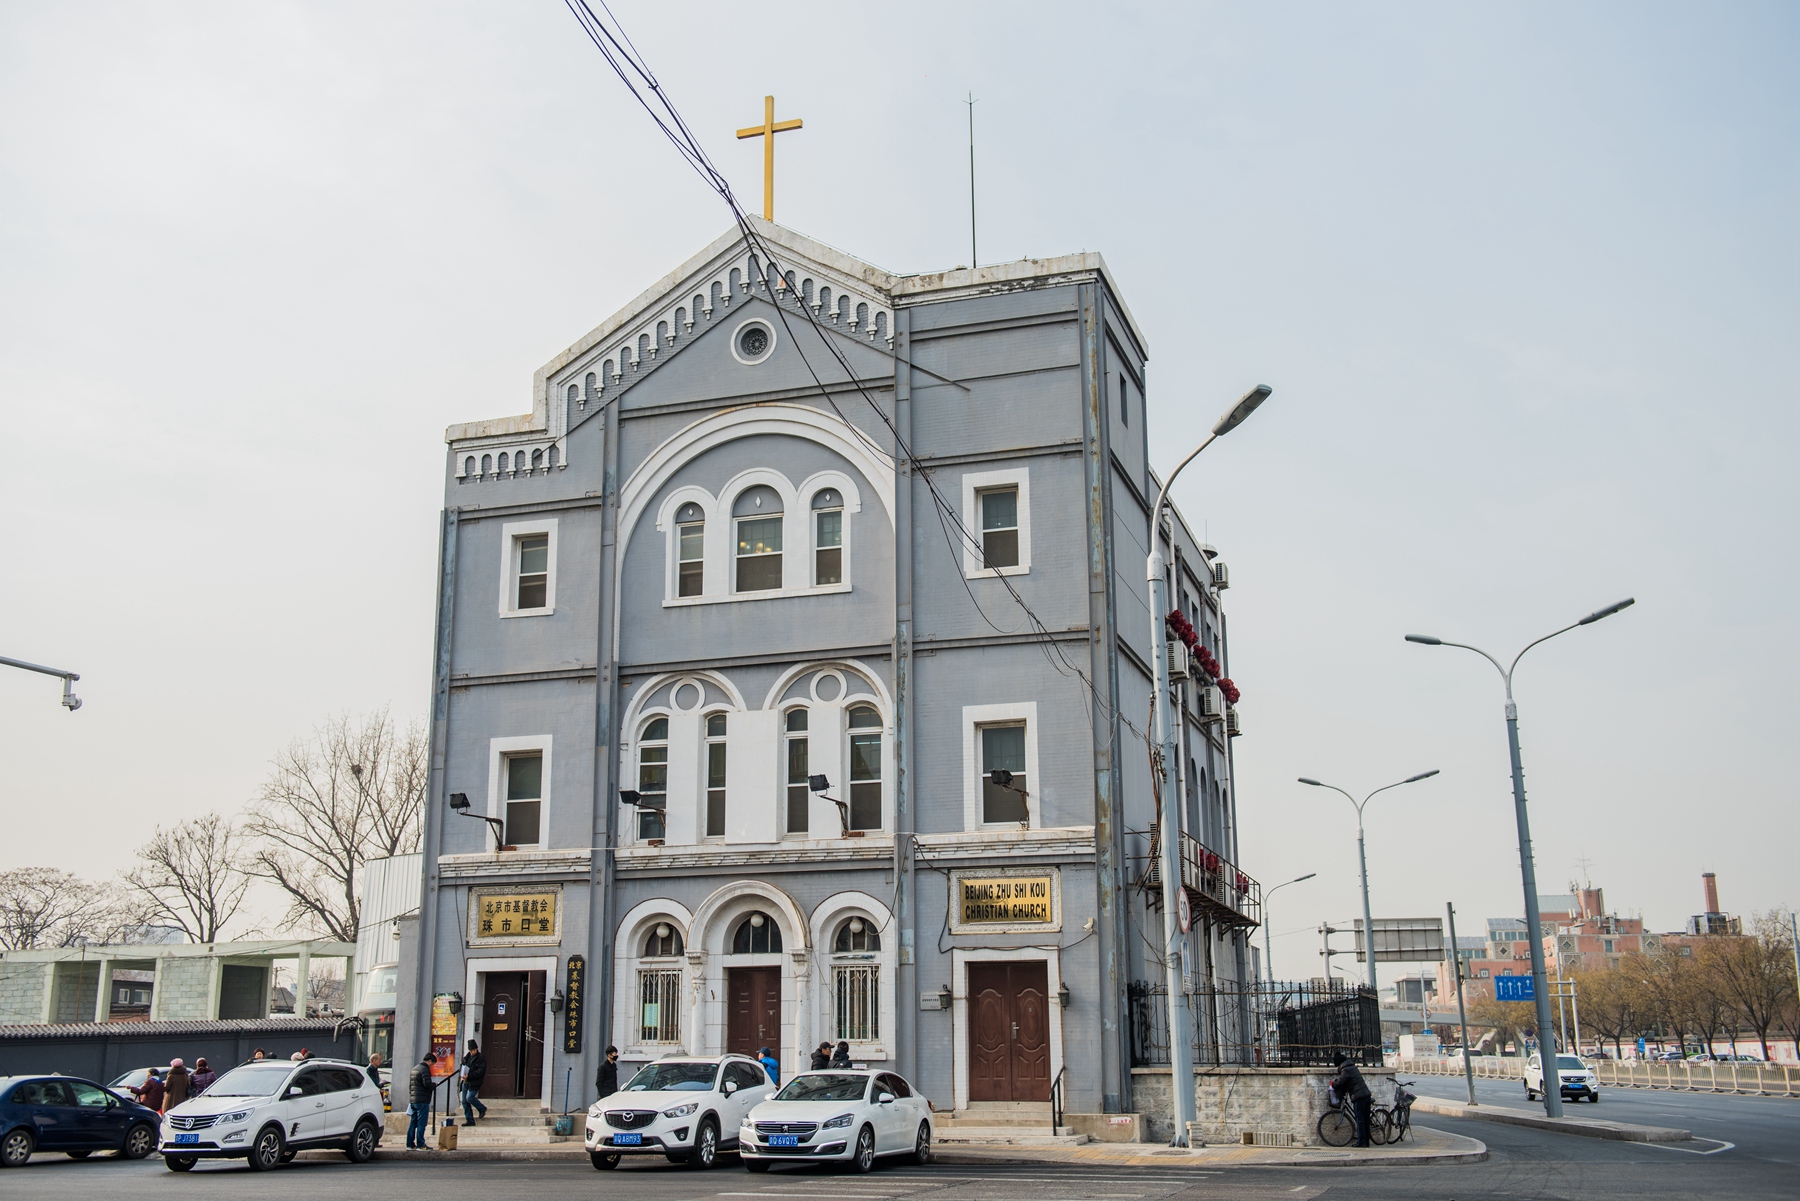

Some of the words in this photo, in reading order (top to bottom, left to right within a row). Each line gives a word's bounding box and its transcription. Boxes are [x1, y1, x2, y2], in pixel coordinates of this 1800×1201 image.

[965, 884, 993, 900] BEIJING
[996, 884, 1011, 899] ZHU
[1014, 883, 1027, 898] SHI
[1030, 882, 1046, 898] KOU
[485, 898, 548, 914] 北京市基督教会
[965, 904, 1009, 919] CHRISTIAN
[1012, 903, 1047, 918] CHURCH
[482, 917, 550, 933] 珠市口堂
